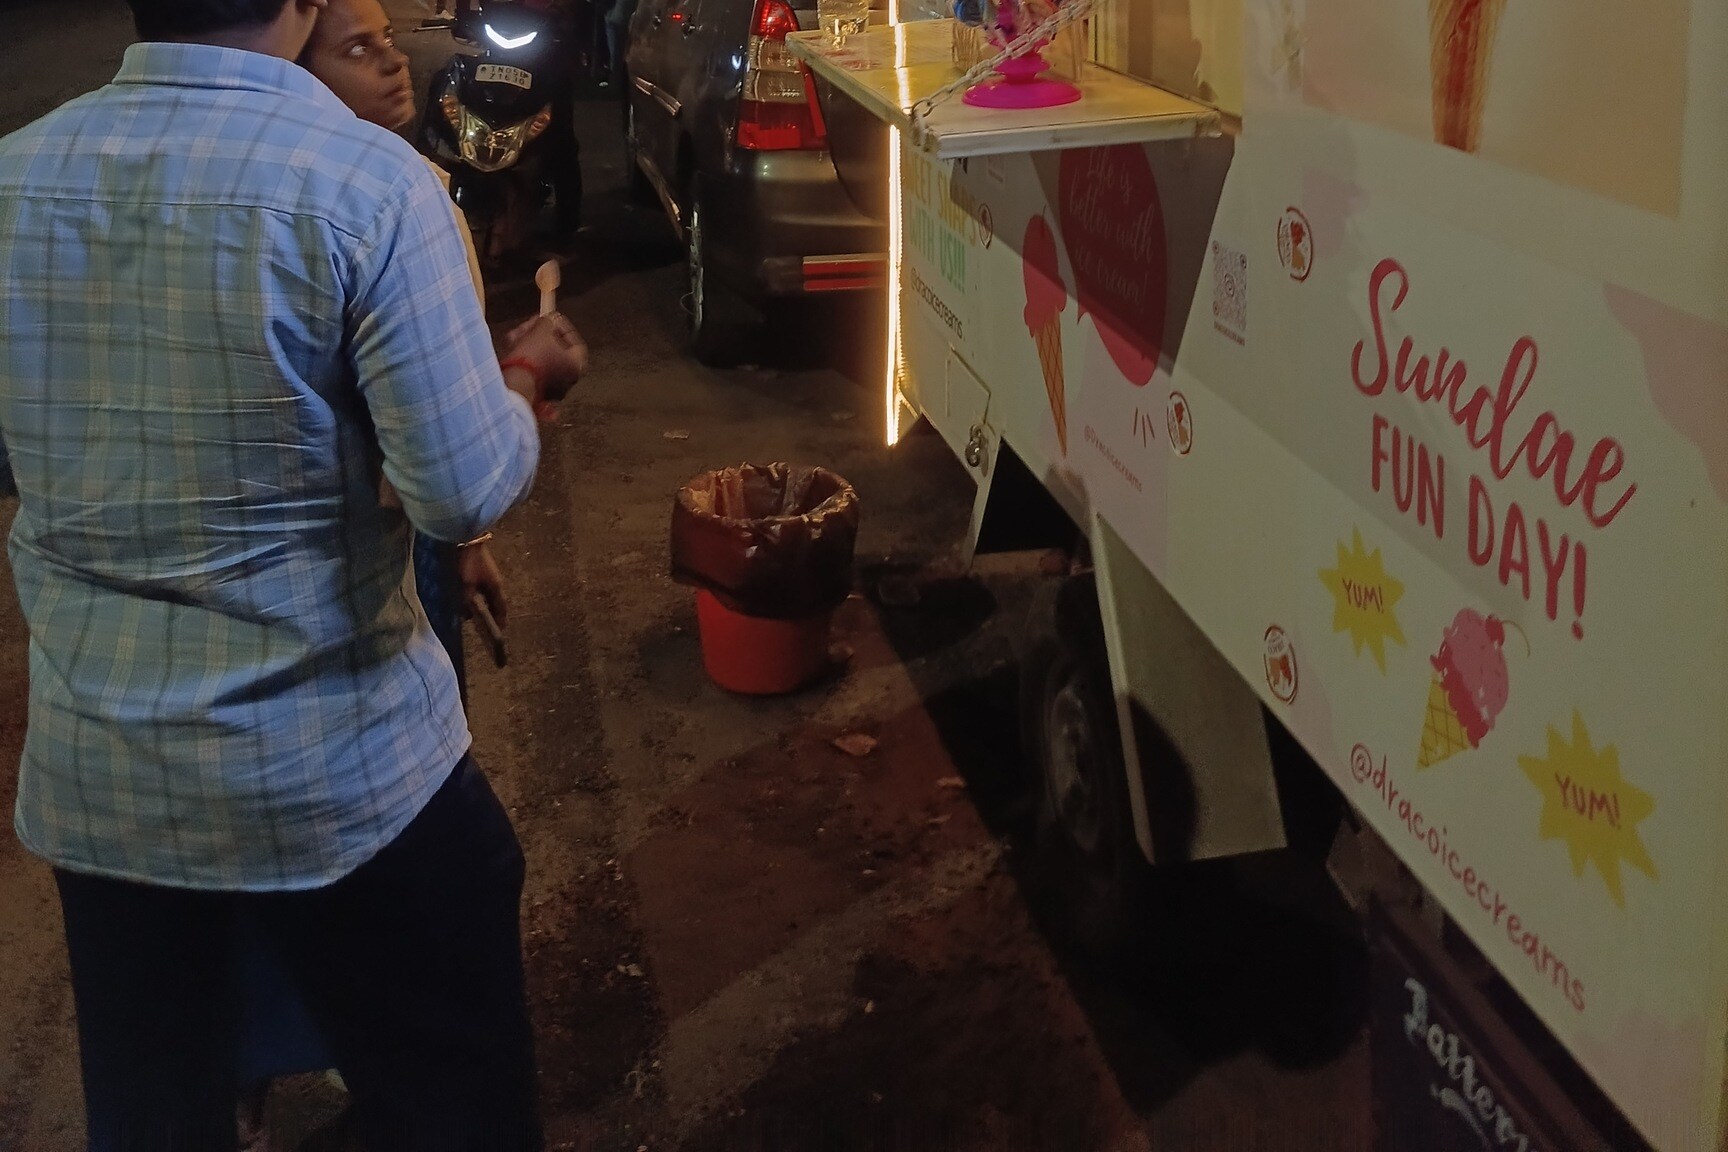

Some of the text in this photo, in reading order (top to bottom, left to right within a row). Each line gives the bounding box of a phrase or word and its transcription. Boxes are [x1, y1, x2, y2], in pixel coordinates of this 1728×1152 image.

[1351, 257, 1638, 529] Sundae
[1340, 576, 1386, 614] YUM!
[1370, 411, 1588, 642] FUN DAY!
[1349, 741, 1588, 1013] @dracoicecreams
[1553, 769, 1623, 832] YUM!
